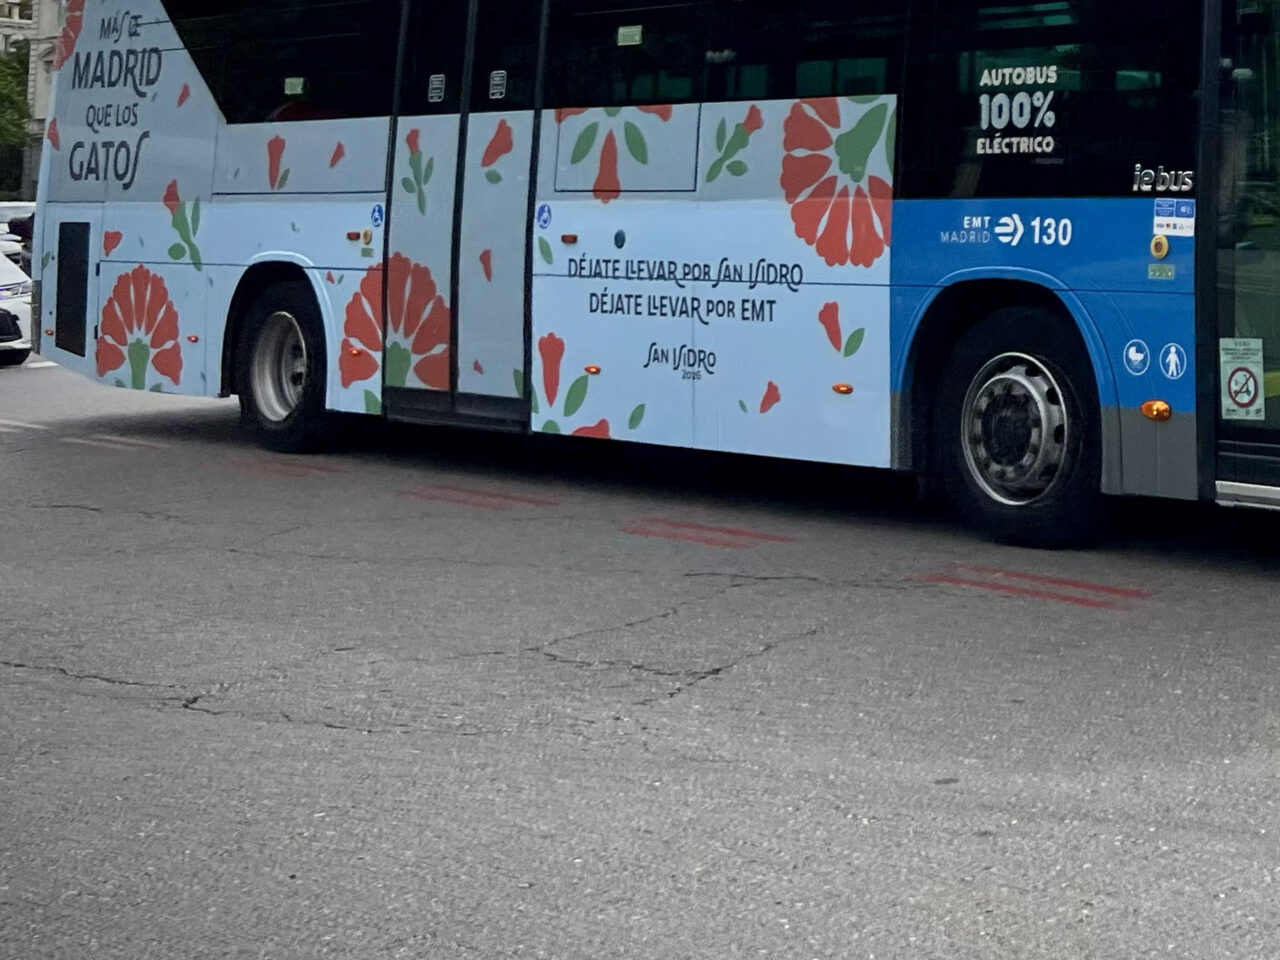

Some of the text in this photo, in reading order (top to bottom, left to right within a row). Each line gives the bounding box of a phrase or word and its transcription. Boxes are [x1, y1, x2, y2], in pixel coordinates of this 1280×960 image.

[72, 47, 162, 97] MADRID
[979, 66, 1057, 86] AUTOBUS
[86, 103, 139, 133] QUE LOS
[979, 90, 1056, 130] 100%
[976, 133, 1055, 154] ELÉCTRICO
[69, 130, 149, 190] GATOS
[940, 231, 991, 243] MADRID
[963, 216, 1073, 245] EMT 130
[568, 253, 621, 279] DÉJATE
[625, 259, 685, 288] LLEVAR
[683, 263, 711, 281] POR
[712, 257, 743, 288] SAN
[589, 288, 777, 325] DÉJATE LLEVAR POR EMT
[643, 342, 716, 374] SAN ISIDRO
